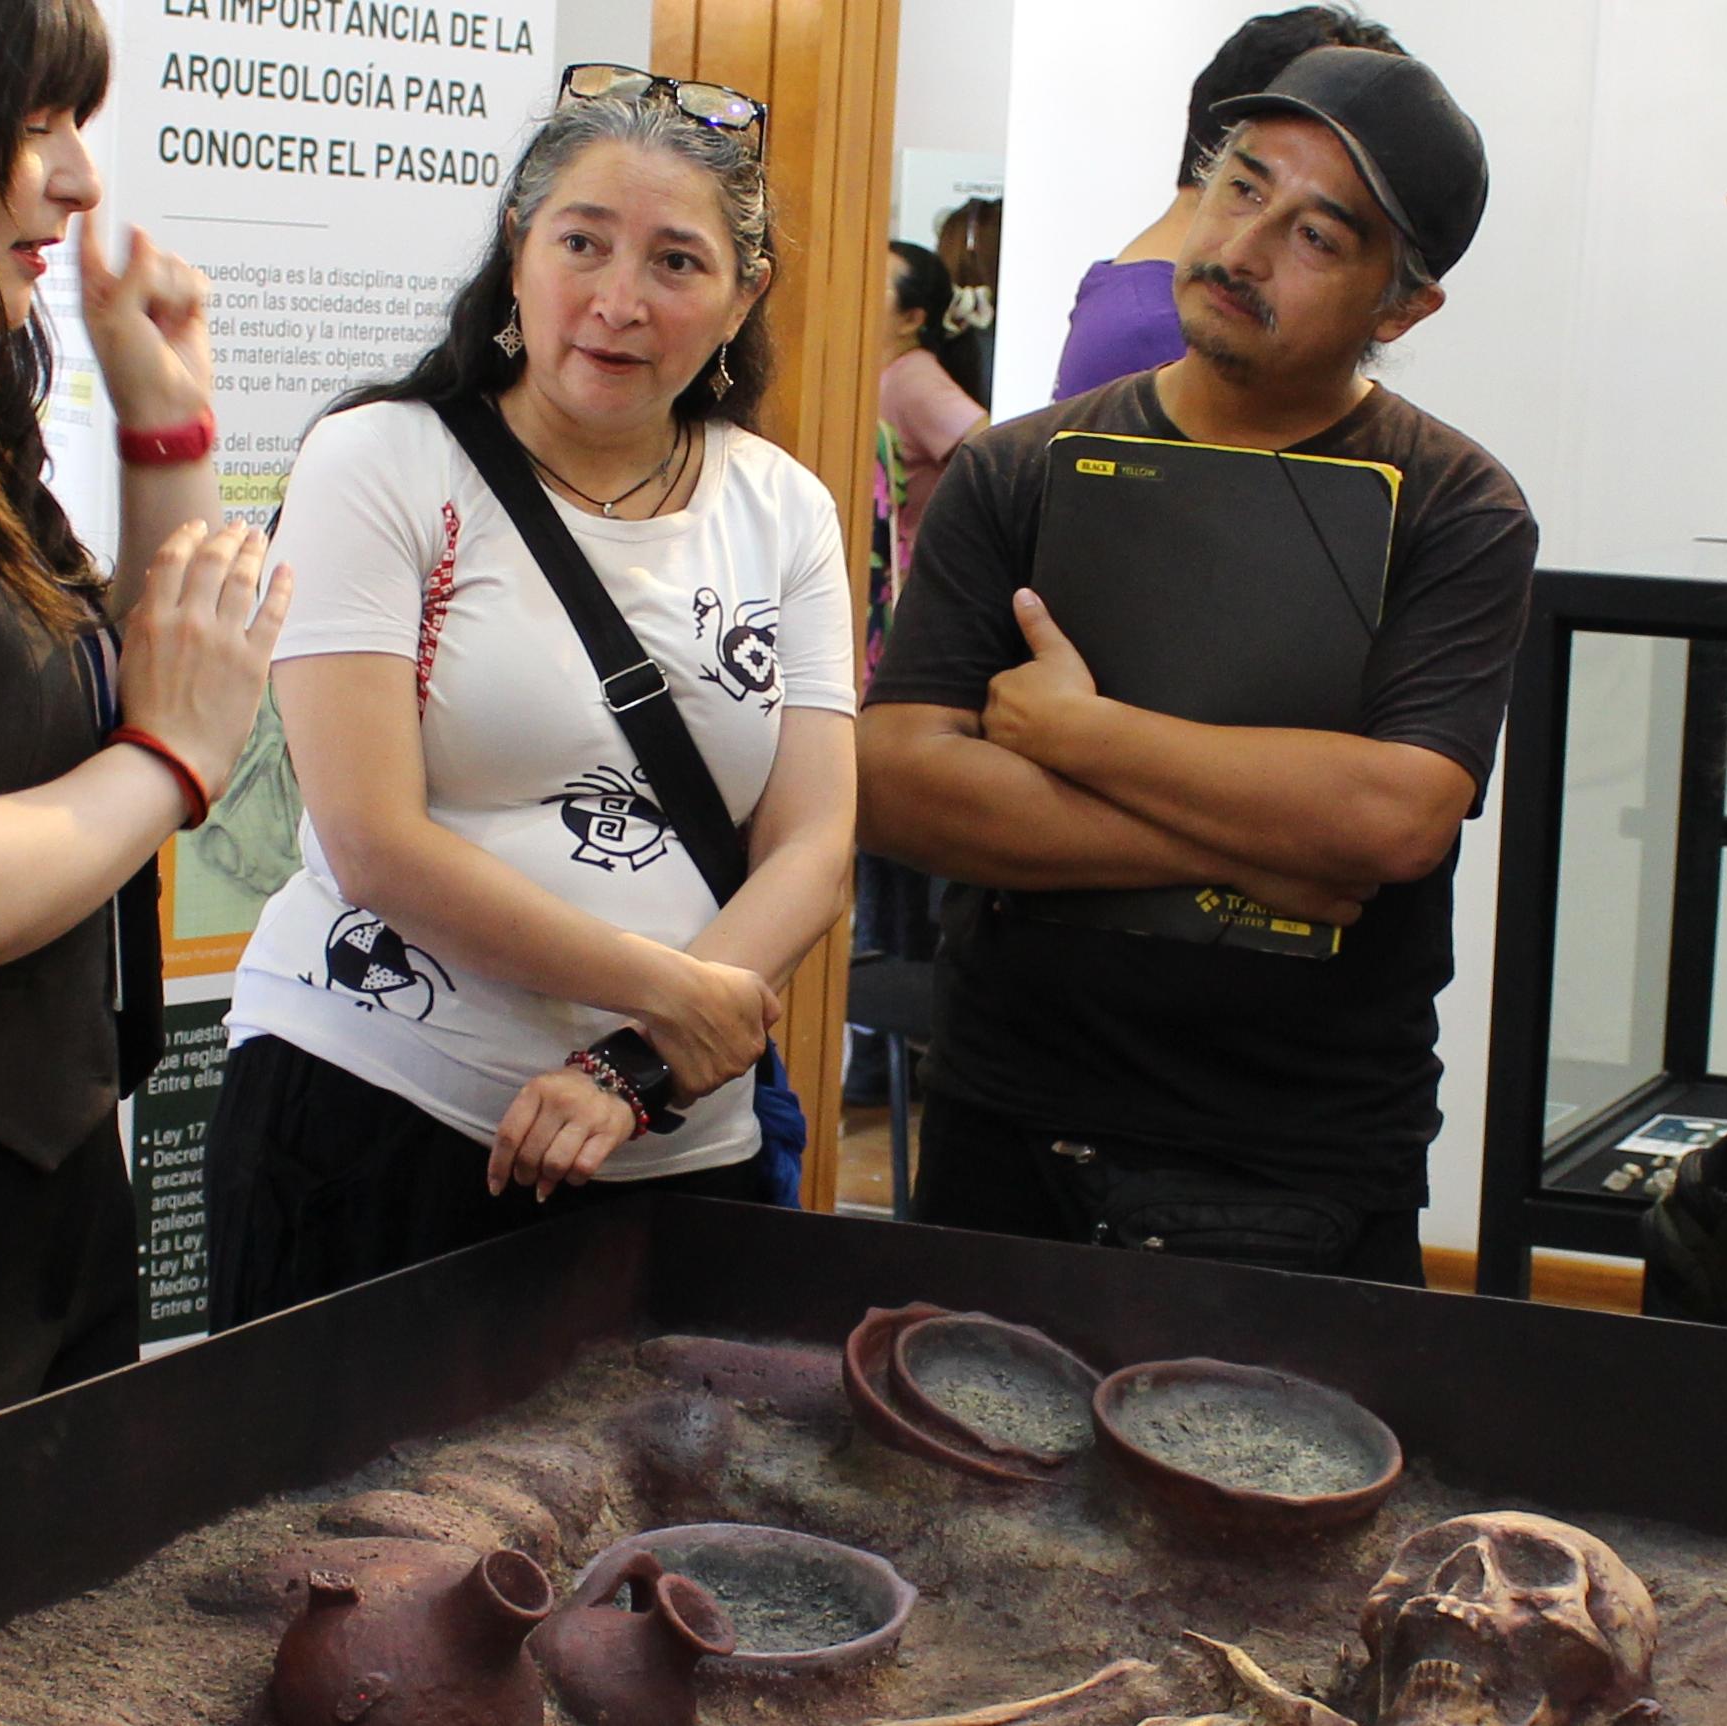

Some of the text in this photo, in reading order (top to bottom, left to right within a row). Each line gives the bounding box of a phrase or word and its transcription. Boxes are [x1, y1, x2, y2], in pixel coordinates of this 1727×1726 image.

[220, 0, 441, 44] IMPORTANCIA
[449, 11, 488, 50] DE
[495, 16, 534, 56] LA
[160, 51, 488, 119] ARQUEOLOGÍA PARA
[158, 124, 500, 188] CONOCER EL PASADO
[286, 267, 305, 286] es
[309, 264, 323, 286] la
[327, 266, 404, 292] disciplina
[407, 273, 437, 293] que
[226, 292, 258, 310] con
[262, 289, 287, 311] las
[290, 292, 381, 315] sociedades
[385, 296, 411, 316] del
[208, 316, 236, 336] del
[239, 318, 303, 339] estudio
[305, 324, 317, 342] y
[319, 320, 334, 340] la
[231, 345, 322, 367] materiales:
[238, 375, 272, 396] que
[275, 372, 306, 392] han
[224, 431, 251, 453] del
[1080, 461, 1158, 478] BLACK YELLOW
[154, 1053, 181, 1075] ue
[147, 1074, 191, 1095] Entre
[153, 1121, 207, 1148] Ley 17
[150, 1233, 204, 1256] La Ley
[150, 1260, 180, 1278] Ley
[149, 1275, 201, 1299] Medio
[150, 1298, 193, 1320] Entre
